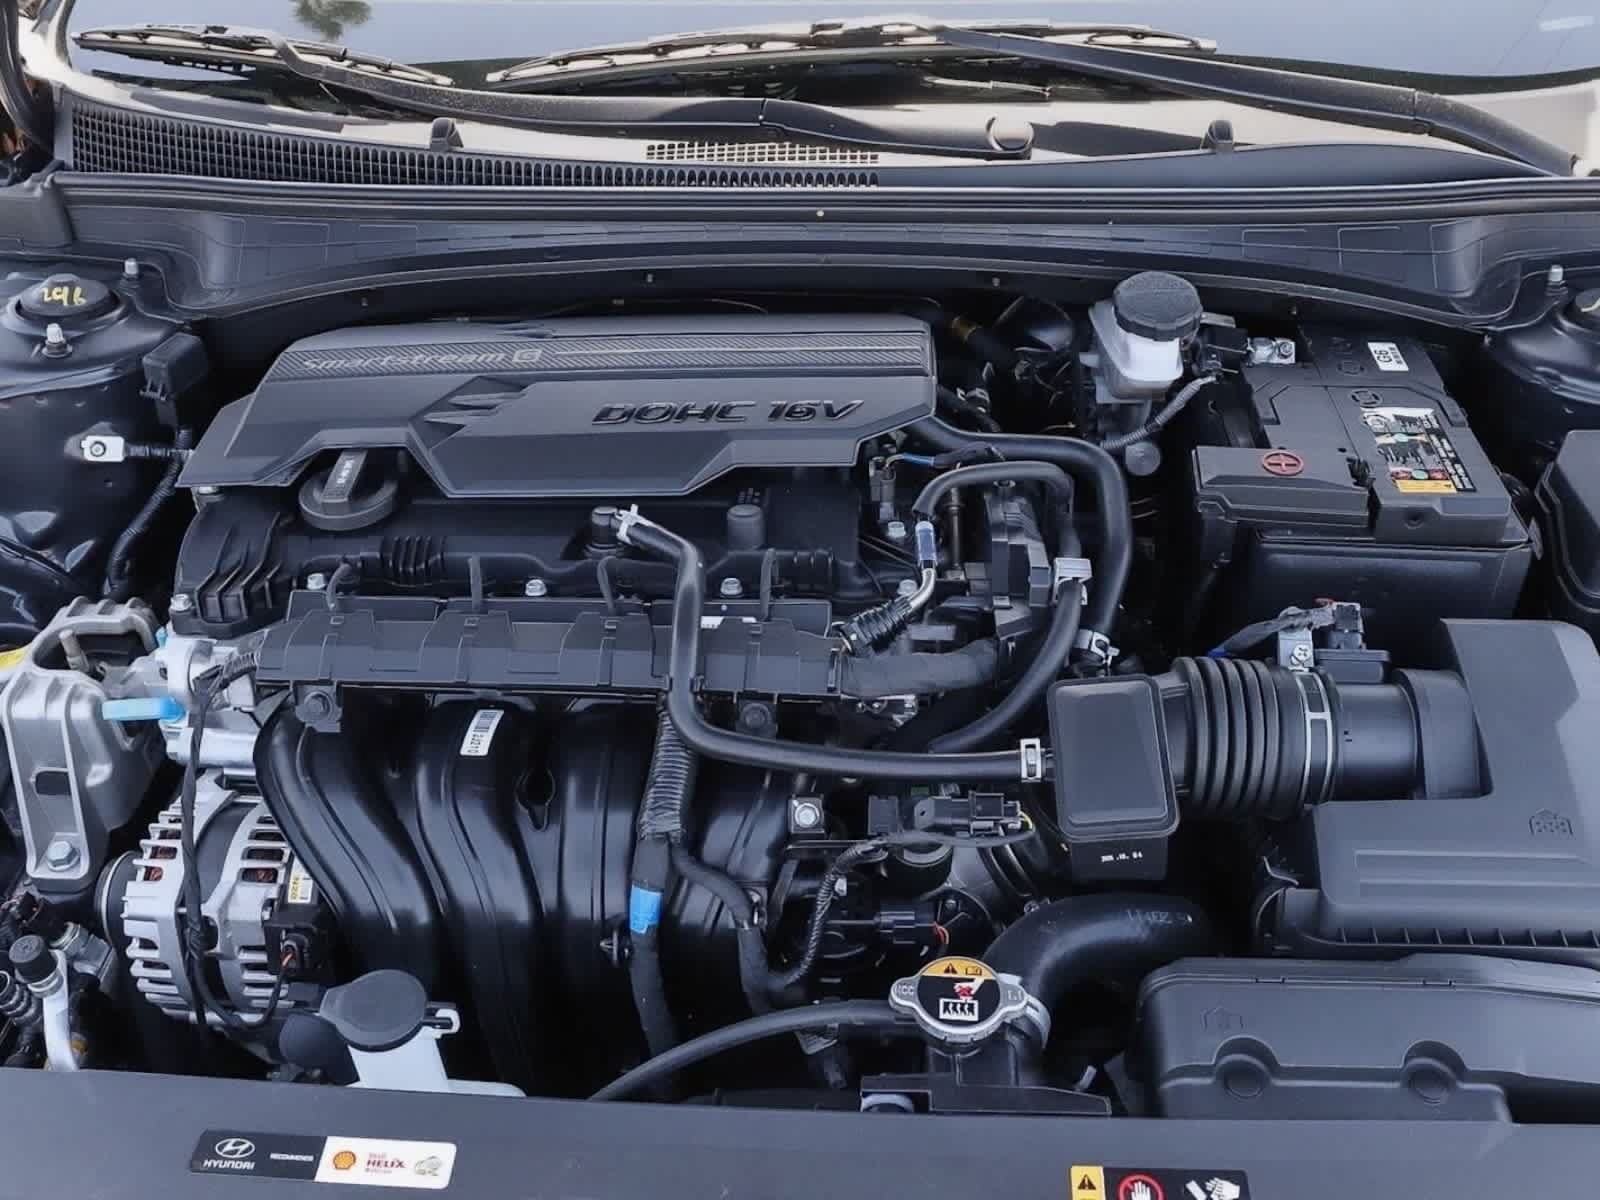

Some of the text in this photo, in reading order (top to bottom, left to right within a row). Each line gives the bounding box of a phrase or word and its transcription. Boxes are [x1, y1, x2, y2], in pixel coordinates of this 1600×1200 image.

[592, 400, 865, 425] DOHC 16V
[203, 1159, 256, 1171] HYUNDAI
[366, 1159, 406, 1169] HELIX
